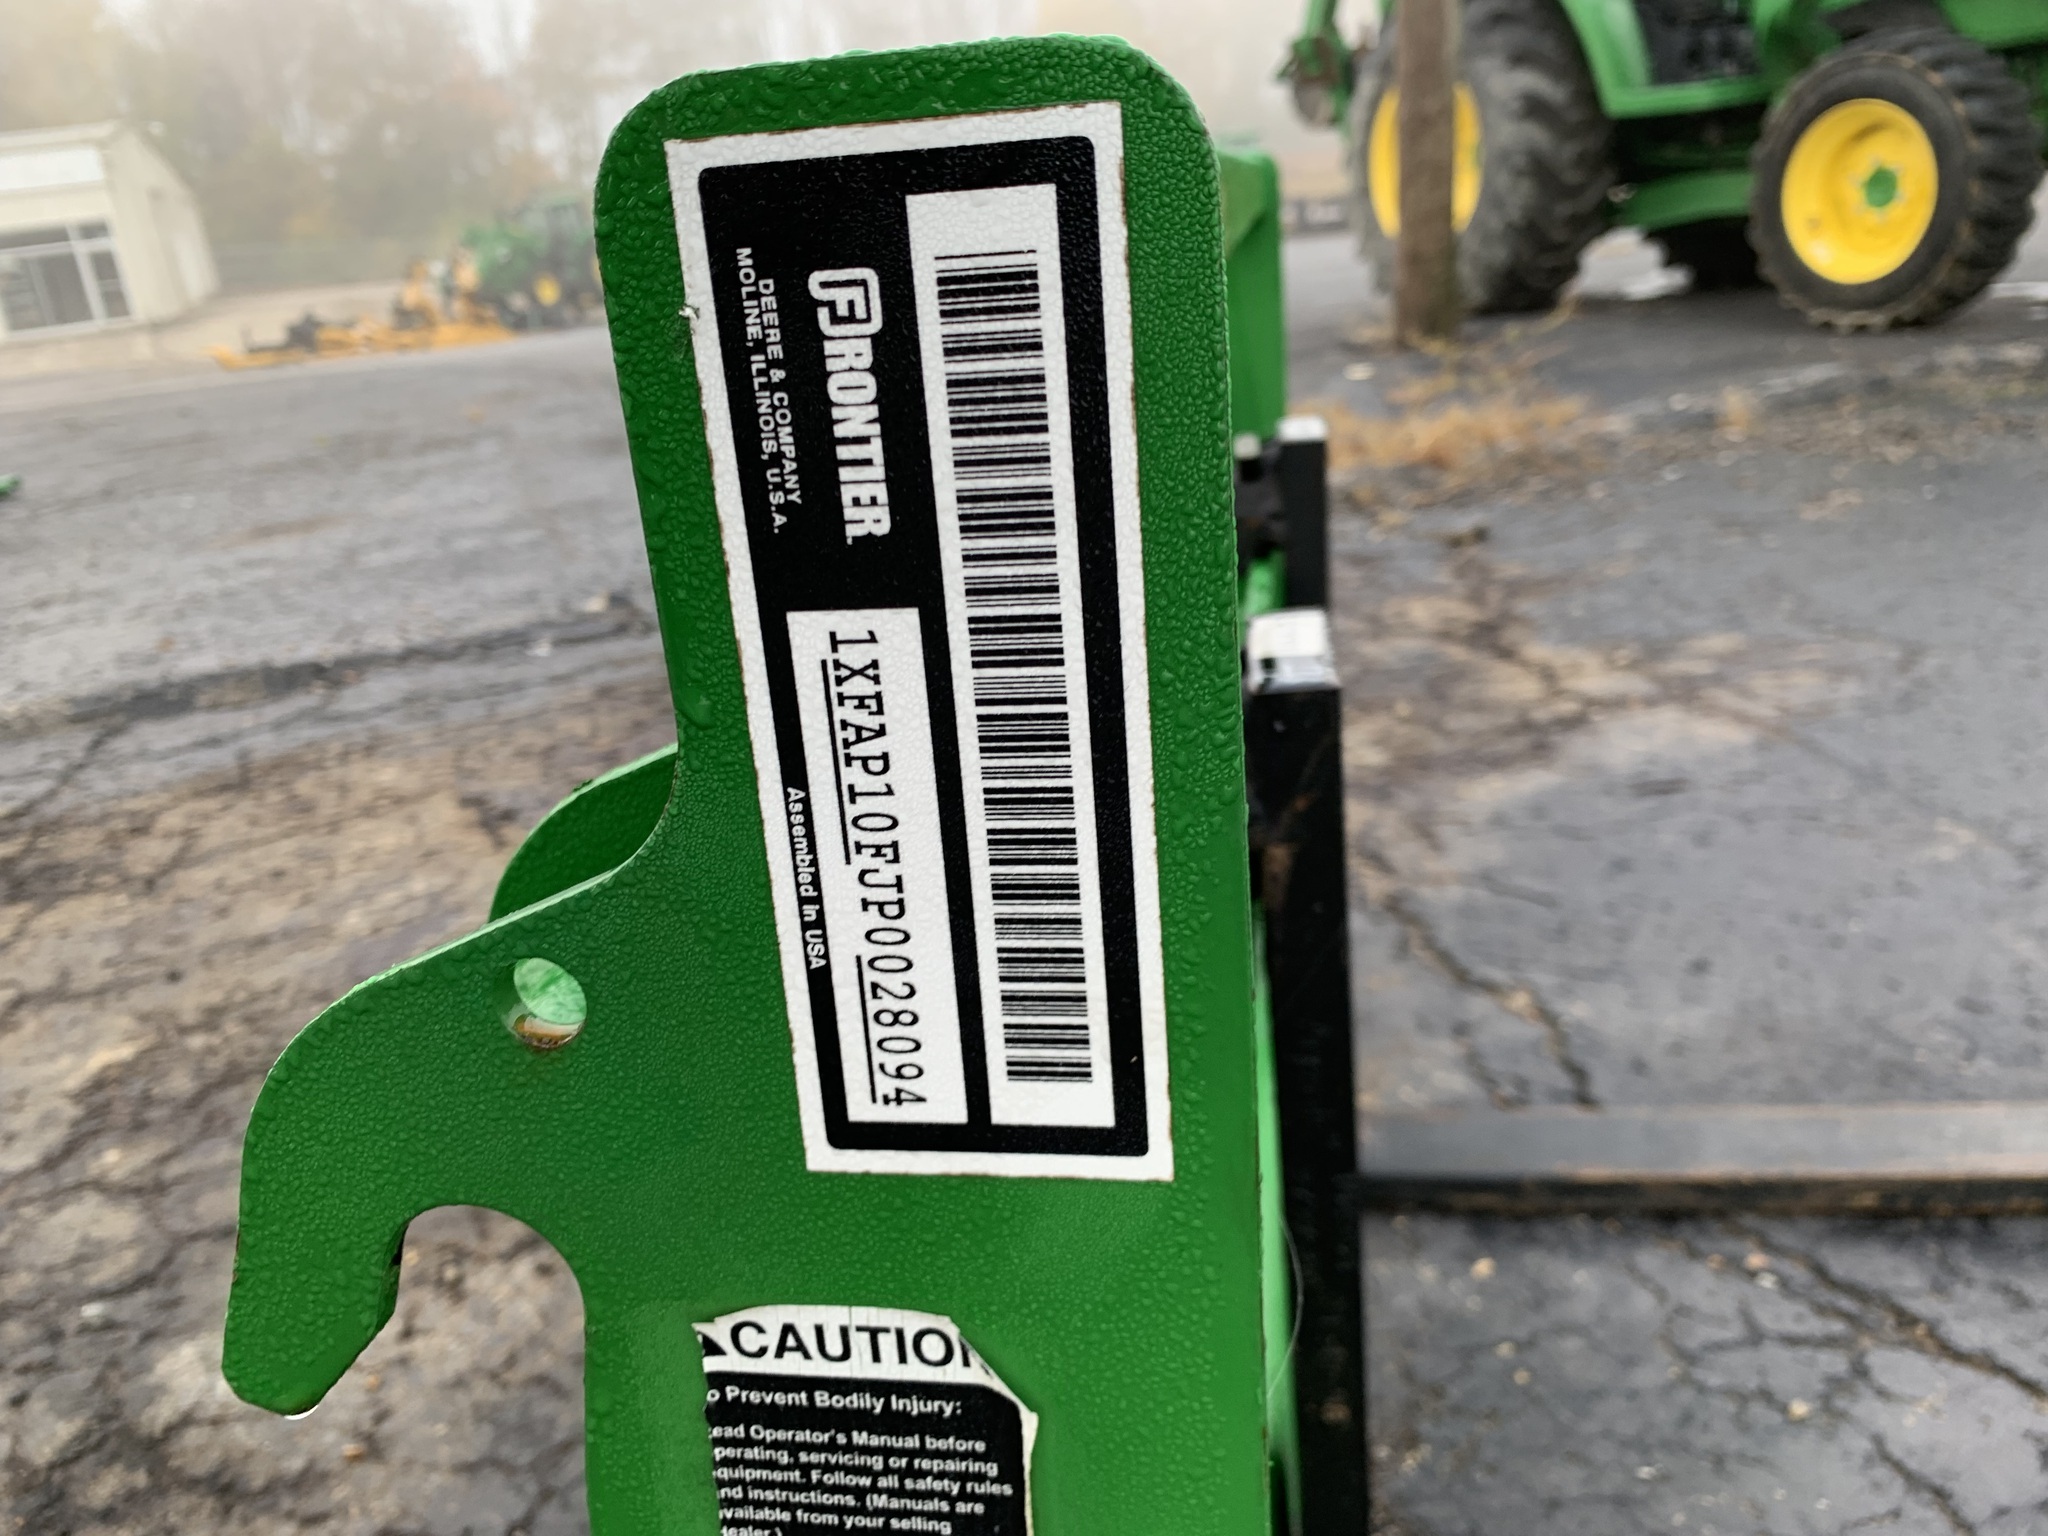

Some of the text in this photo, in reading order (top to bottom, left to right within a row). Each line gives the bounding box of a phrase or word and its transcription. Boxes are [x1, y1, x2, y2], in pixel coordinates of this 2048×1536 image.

[736, 247, 788, 535] MOLINE, ILLINOIS, U.S.A.
[758, 279, 802, 505] DEERE & COMPANY
[808, 267, 891, 538] FRONTIER
[787, 786, 827, 970] Assembled in USA
[829, 630, 928, 1107] 1XFAP10FJP0028094
[706, 1385, 963, 1418] o Prevent Bodily Injury:
[708, 1423, 986, 1453] ead Operator's Manual before
[713, 1445, 998, 1478] perating, servicing or repairing
[712, 1464, 1013, 1497] quipment. Follow all safety rules
[747, 1485, 861, 1508] instructions.
[865, 1492, 951, 1513] (Manuals
[955, 1500, 986, 1515] are
[796, 1507, 840, 1527] from
[842, 1513, 886, 1530] your
[889, 1516, 953, 1536] selling
